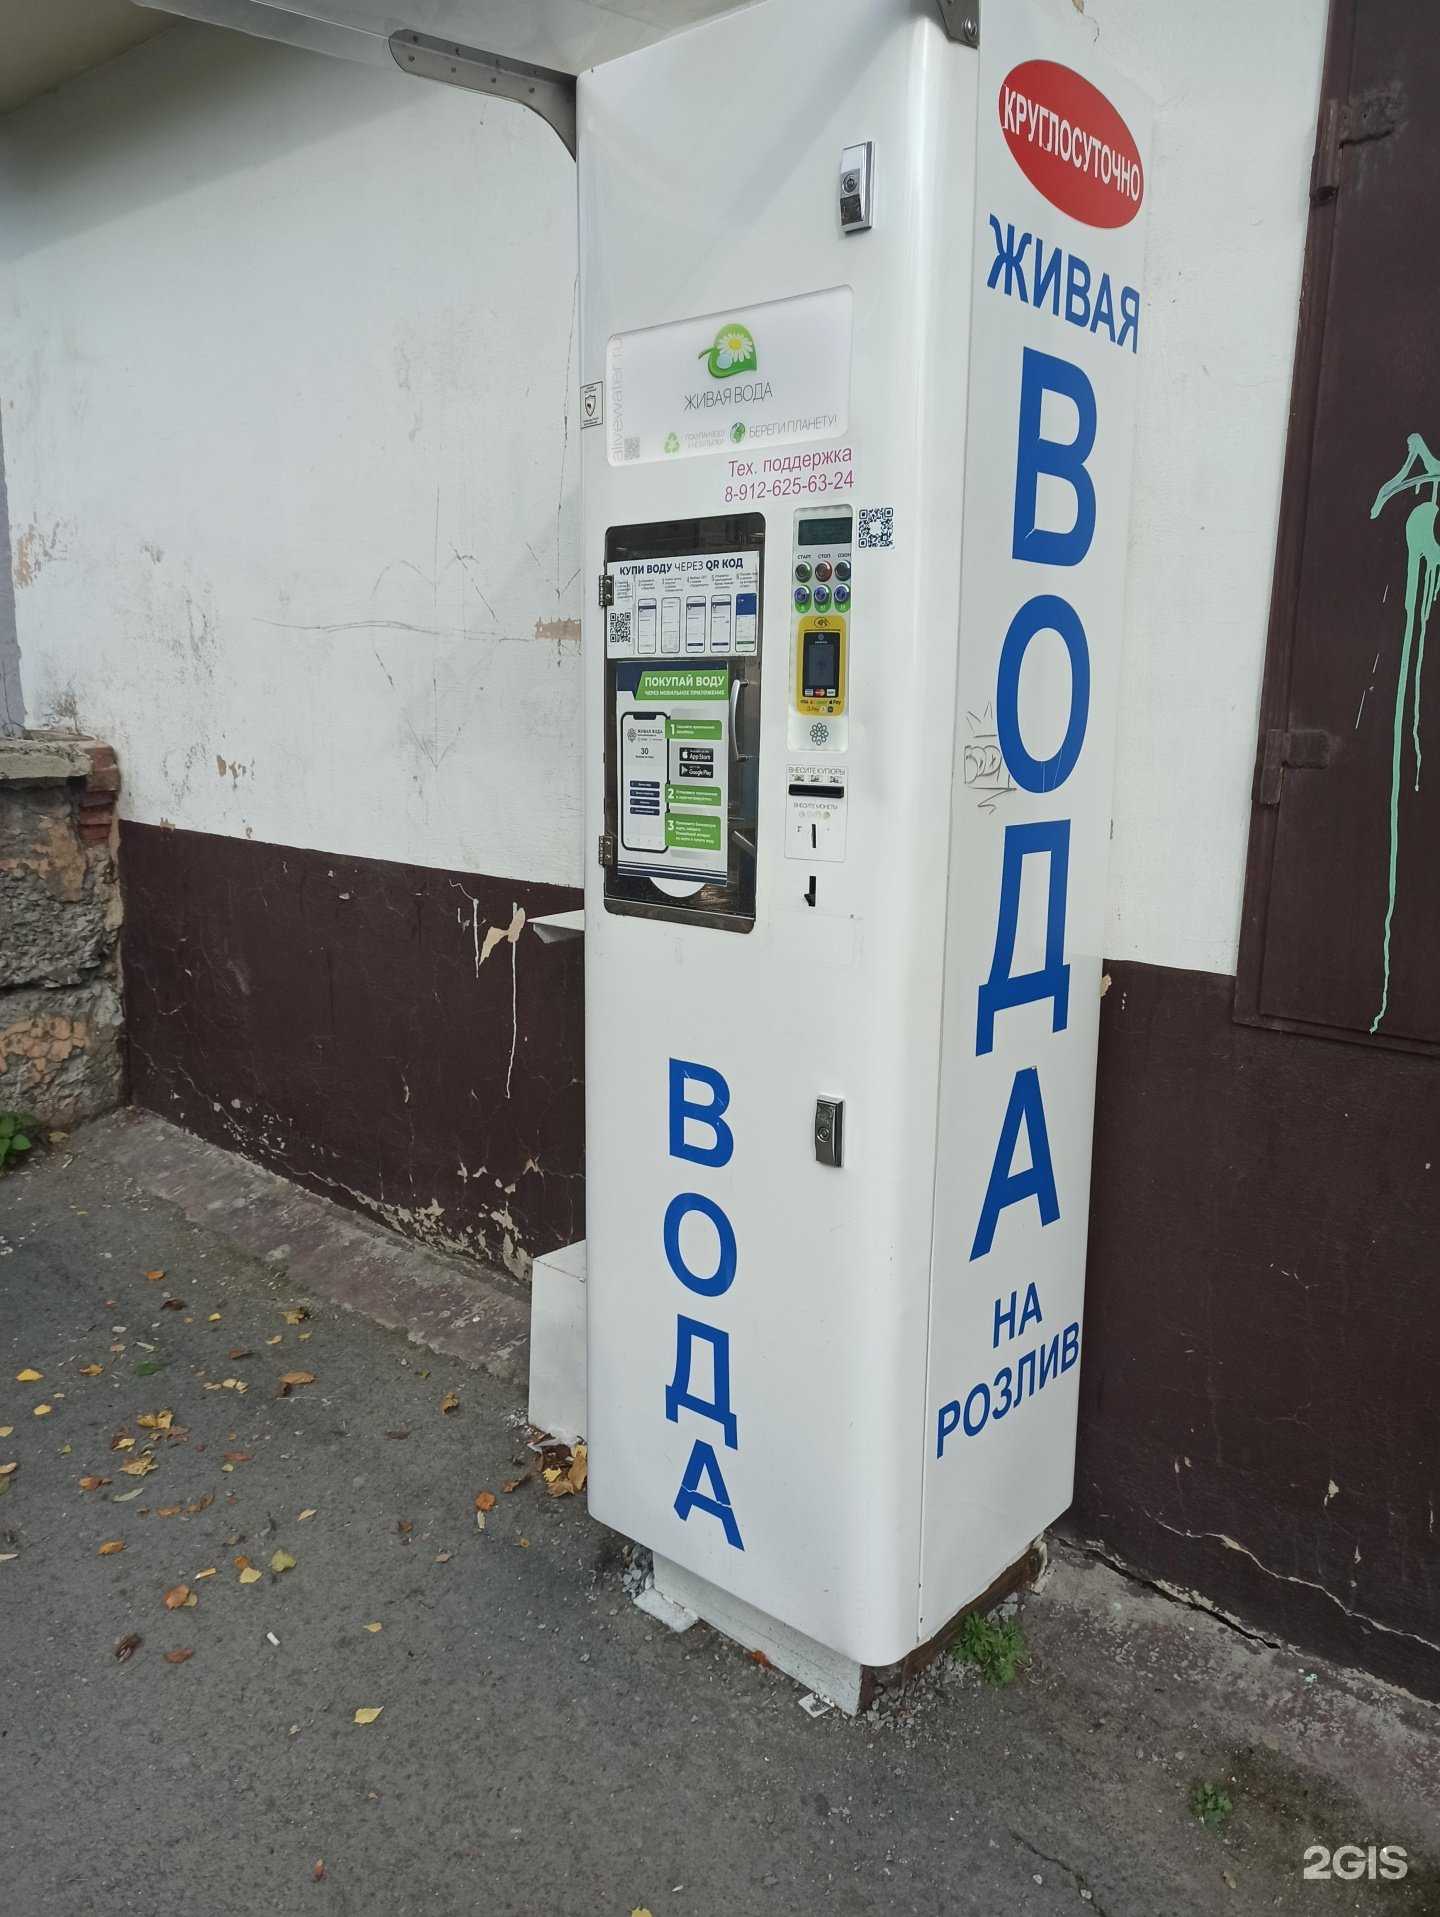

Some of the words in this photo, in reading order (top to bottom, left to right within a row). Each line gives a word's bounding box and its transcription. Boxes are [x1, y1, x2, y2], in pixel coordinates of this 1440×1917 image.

[1003, 86, 1140, 201] КРУГЛОСУТОЧНО
[987, 213, 1140, 354] ЖИВАЯ
[683, 387, 732, 411] ЖИВАЯ
[734, 381, 773, 402] ВОДА
[749, 422, 786, 438] БЕРЕГИ
[788, 415, 838, 433] ПЛАНЕТУ!
[728, 460, 758, 478] Тех.
[763, 448, 852, 474] поддержка
[725, 470, 854, 502] 8-912-625-63-24
[619, 565, 645, 576] КУПИ
[646, 563, 673, 575] ВОДУ
[674, 560, 704, 572] ЧЕРЕЗ
[705, 559, 719, 570] QR
[722, 557, 744, 569] КОД
[644, 674, 694, 687] ПОКУПАЙ
[695, 676, 725, 688] ВОДУ
[670, 723, 675, 736] 1
[640, 747, 649, 755] 30
[689, 752, 699, 760] App
[688, 768, 703, 777] Google
[667, 788, 674, 799] 2
[969, 346, 1098, 1263] ВОДА
[667, 820, 674, 831] 3
[663, 1057, 745, 1551] ВОДА
[993, 1281, 1042, 1348] НА
[936, 1321, 1079, 1459] РОЗЛИВ
